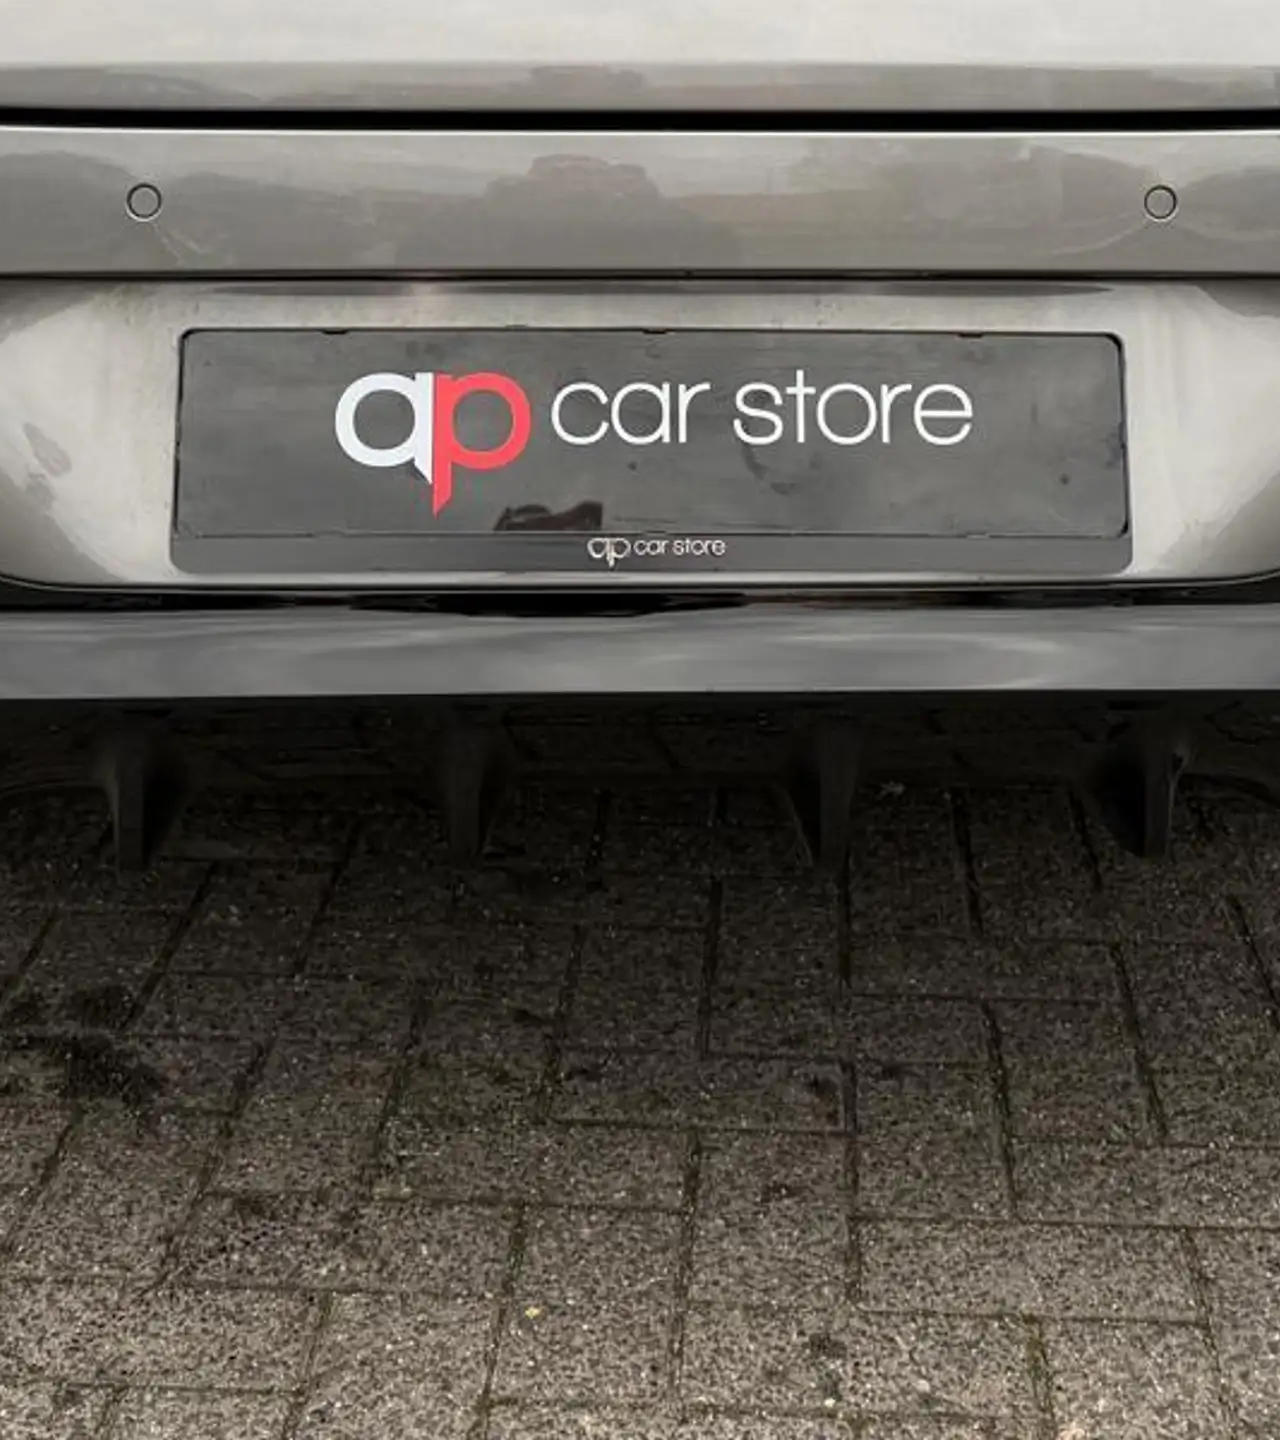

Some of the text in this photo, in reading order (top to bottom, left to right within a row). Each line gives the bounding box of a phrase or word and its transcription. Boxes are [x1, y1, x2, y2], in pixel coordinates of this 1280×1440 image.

[334, 369, 973, 515] ap car store
[587, 537, 726, 568] ap car store
